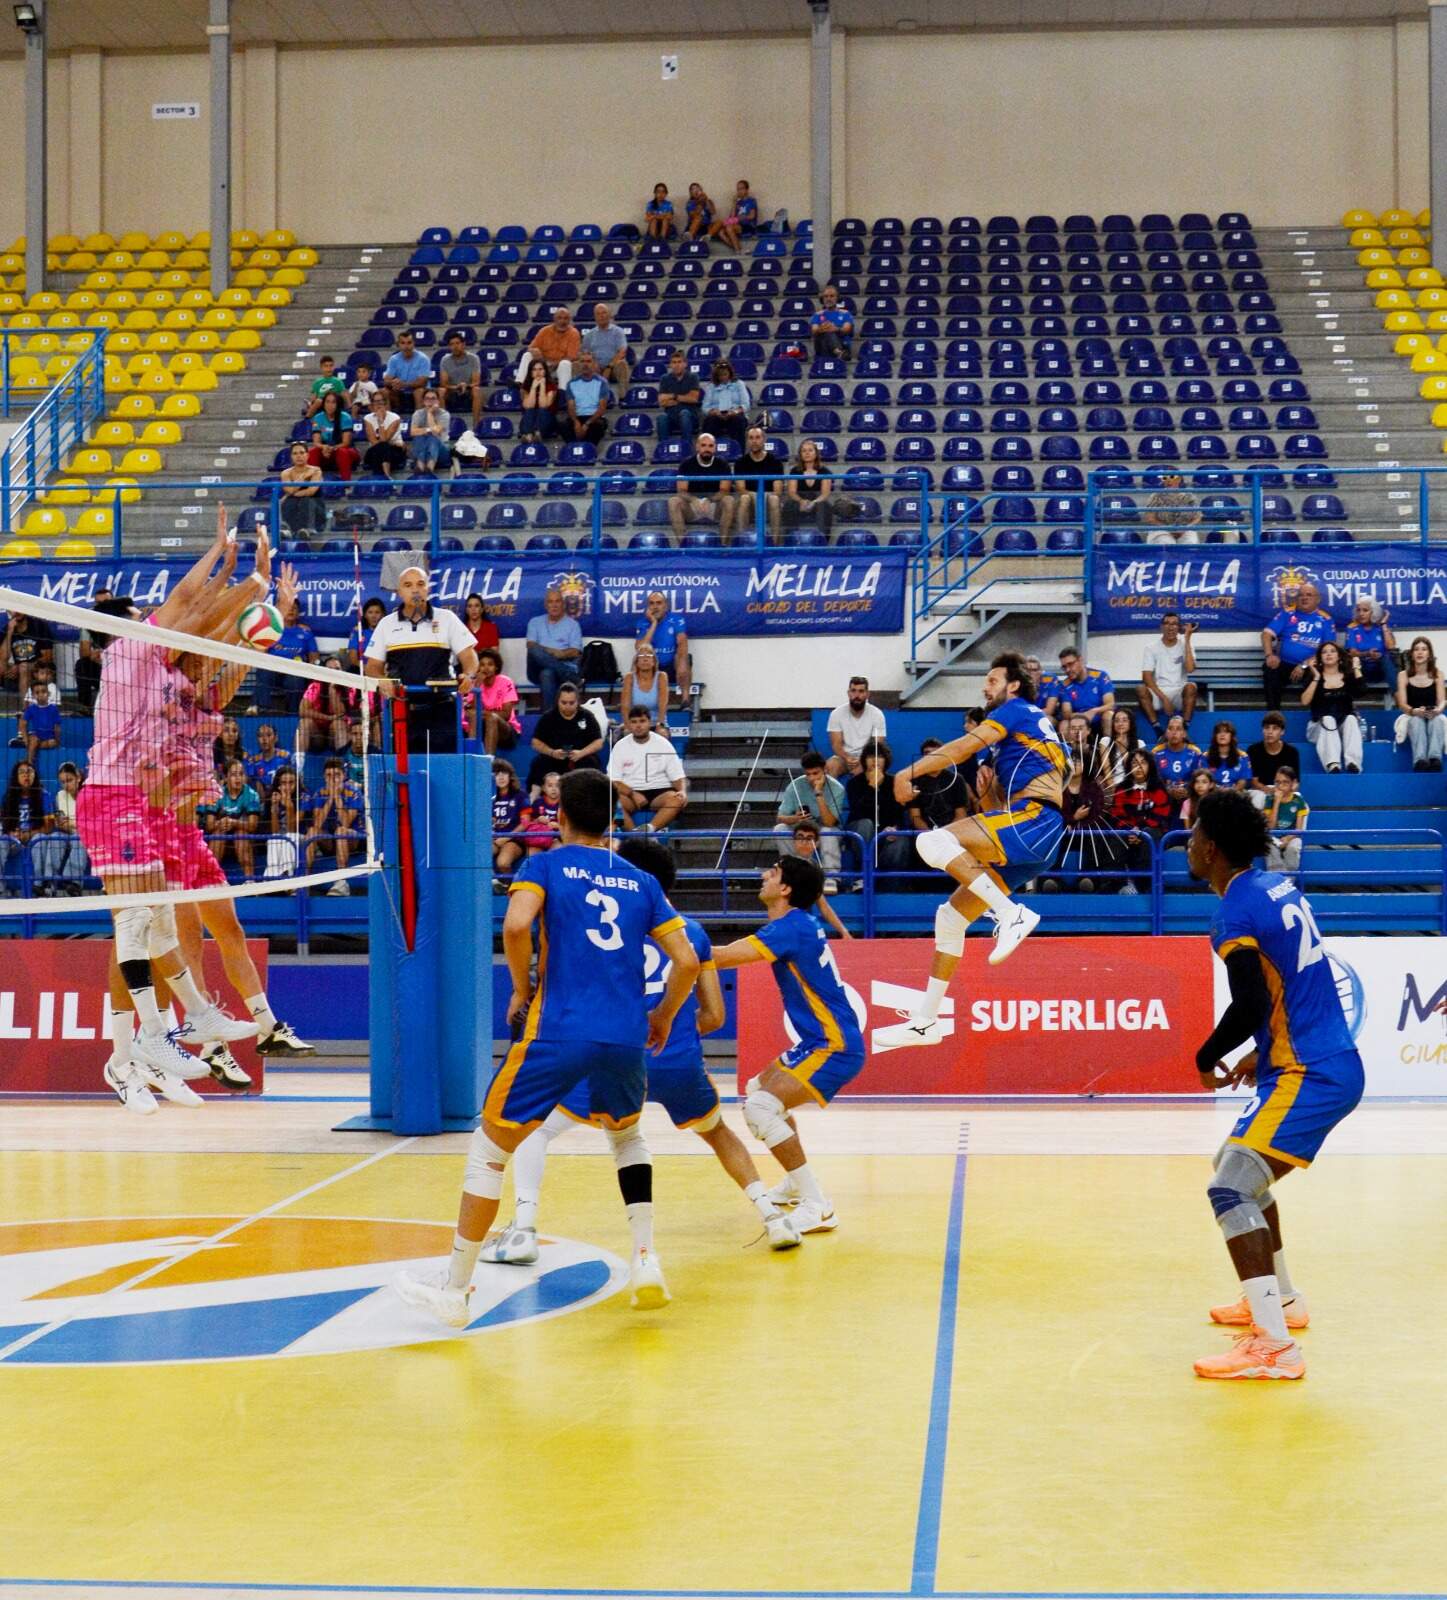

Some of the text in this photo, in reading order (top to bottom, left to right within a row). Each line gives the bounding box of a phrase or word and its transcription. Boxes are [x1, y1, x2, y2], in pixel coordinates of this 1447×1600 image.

[601, 573, 720, 587] CIUDAD AUTÓNOMA
[745, 562, 881, 599] MELILLA
[1107, 559, 1240, 594] MELILLA
[1323, 566, 1447, 580] CIUDAD AUTÓNOMA
[427, 566, 522, 601] ELILLA
[604, 590, 720, 614] MELLA
[746, 600, 873, 614] CIUDAD DEL DEPORTE
[1110, 596, 1235, 609] CIUDAD DEL DEPORTE
[1172, 760, 1182, 773] 6
[1222, 770, 1230, 783] 2
[494, 806, 507, 817] 16
[562, 866, 640, 893] MAABER
[585, 889, 624, 951] 3
[971, 999, 1170, 1031] SUPERLIGA
